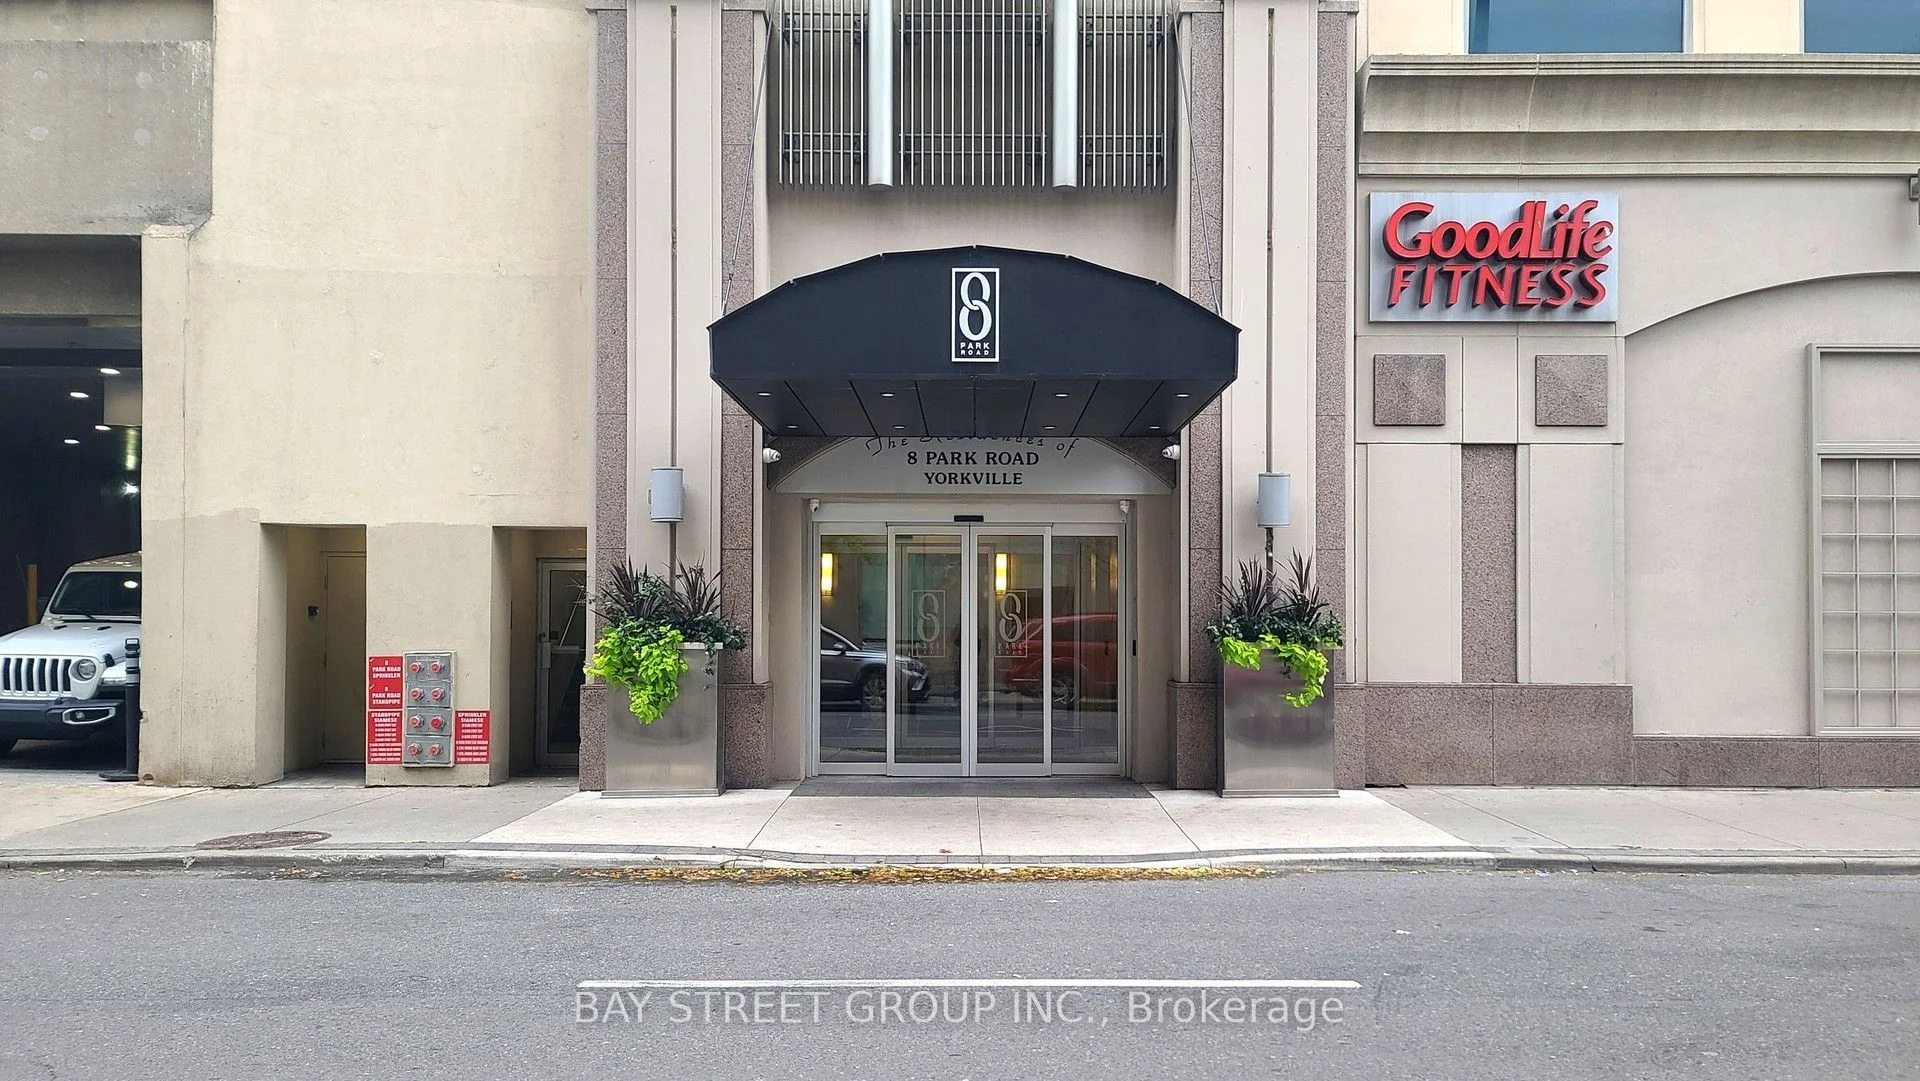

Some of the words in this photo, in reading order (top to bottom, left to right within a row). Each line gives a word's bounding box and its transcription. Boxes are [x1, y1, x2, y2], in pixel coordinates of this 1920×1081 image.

[1383, 200, 1614, 261] GoodLife
[1388, 263, 1609, 308] FITNESS
[959, 272, 992, 341] 8
[907, 451, 918, 465] 8
[925, 451, 978, 465] PARK
[985, 451, 1040, 466] ROAD
[1056, 438, 1080, 459] of
[924, 472, 1024, 485] YORKVILLE
